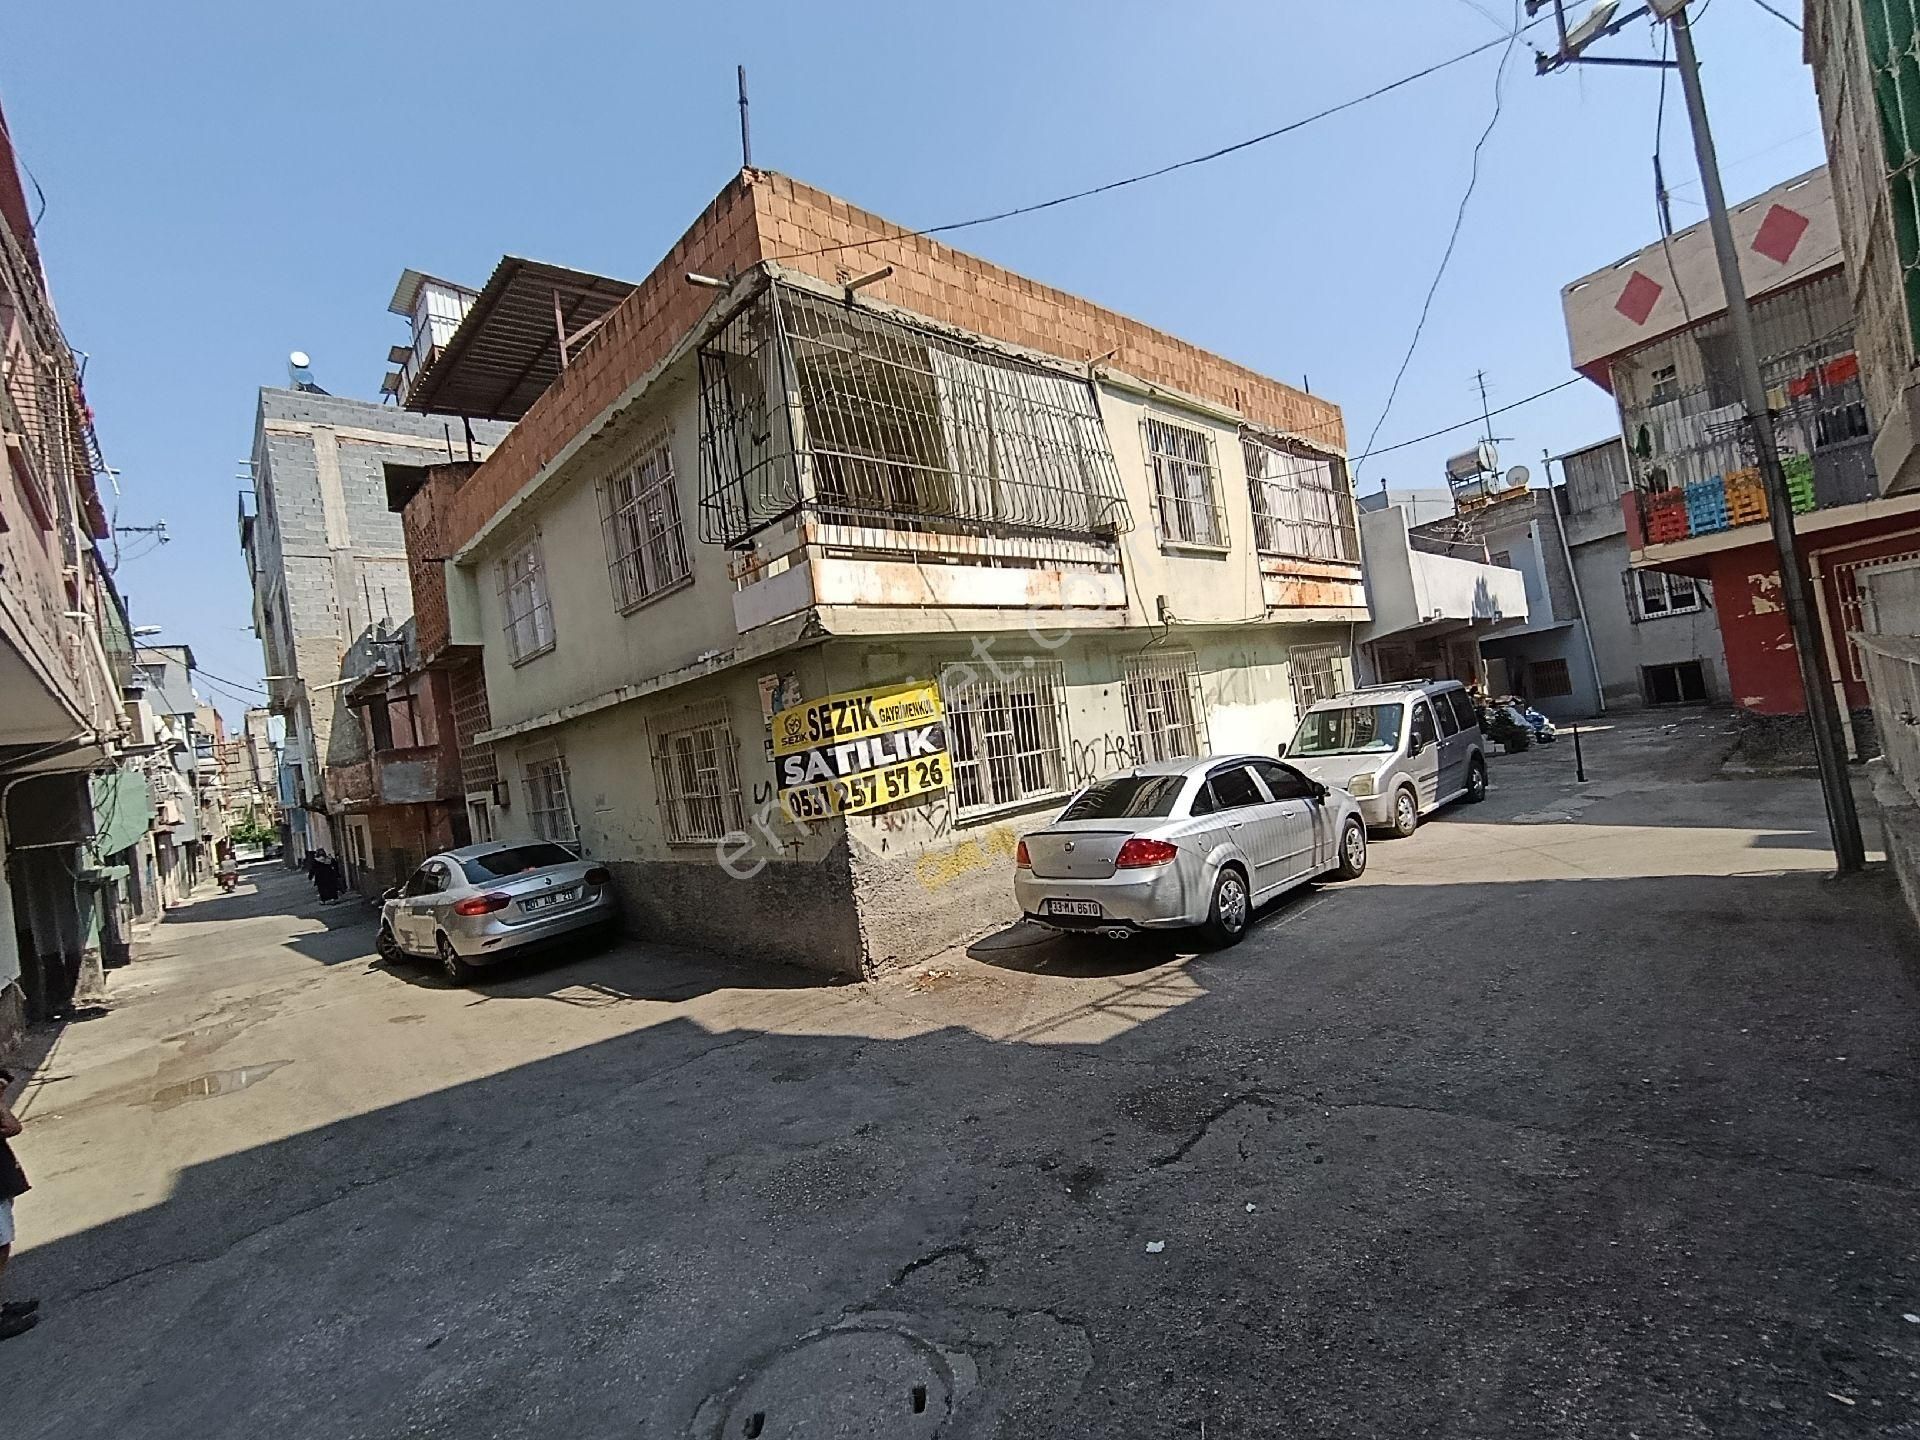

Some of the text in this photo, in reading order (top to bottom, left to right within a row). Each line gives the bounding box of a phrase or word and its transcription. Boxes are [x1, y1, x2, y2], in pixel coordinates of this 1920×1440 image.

[807, 696, 878, 741] SEZİK
[785, 725, 937, 784] SATILIK
[788, 786, 832, 818] 0531
[834, 774, 877, 812] 257
[884, 766, 910, 798] 57
[915, 759, 943, 789] 26
